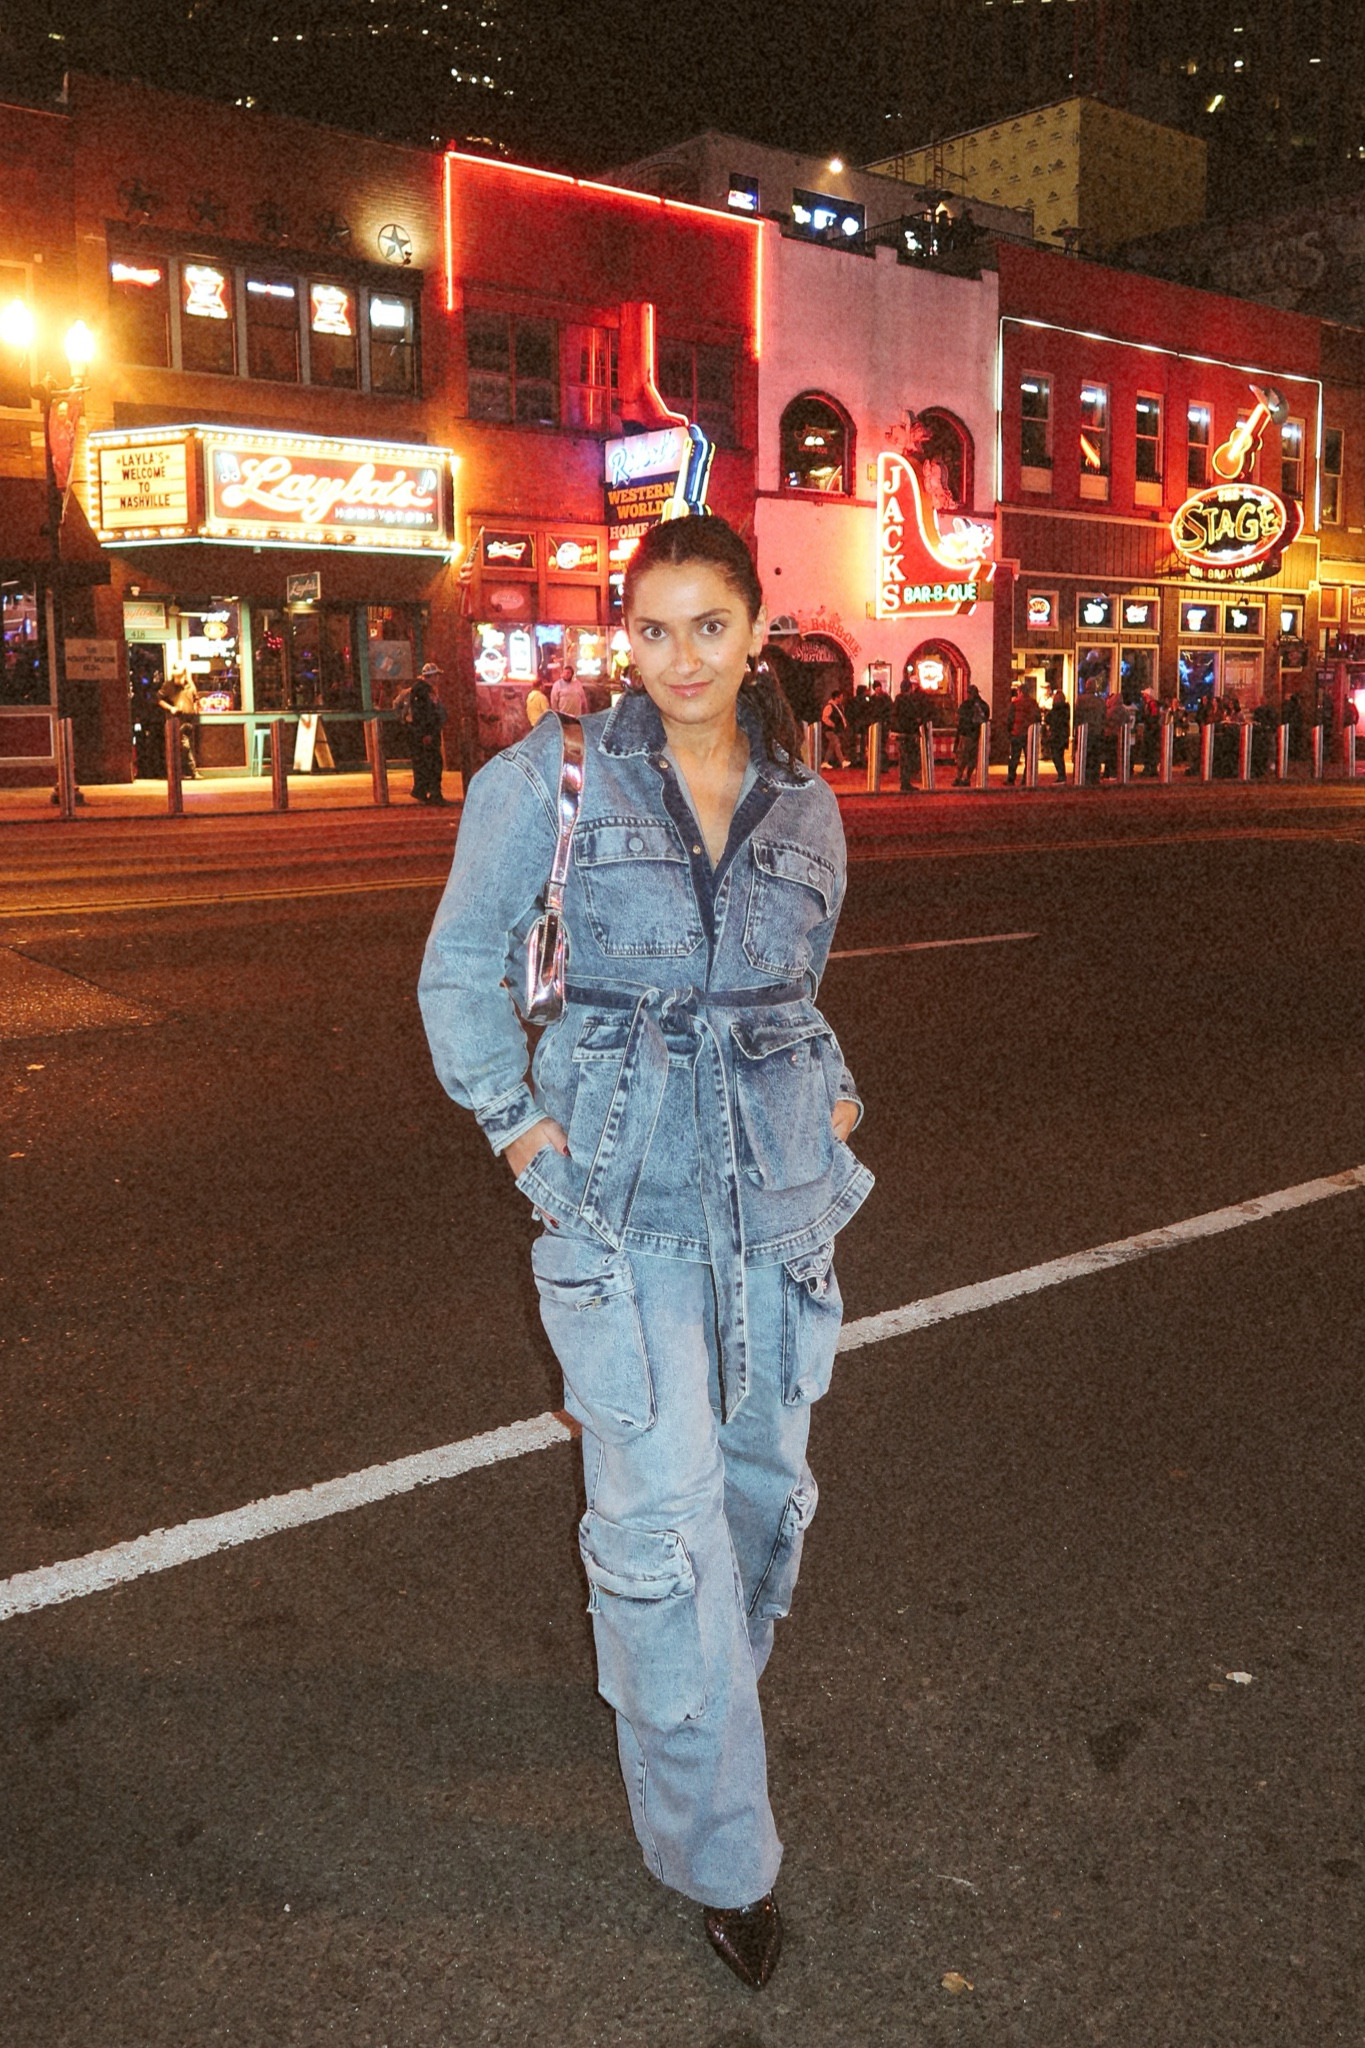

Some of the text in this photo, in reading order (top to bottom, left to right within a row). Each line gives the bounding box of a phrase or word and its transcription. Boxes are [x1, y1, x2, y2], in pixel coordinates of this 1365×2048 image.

[121, 452, 164, 467] LAYLA'S
[122, 466, 166, 481] WELCOME
[138, 481, 151, 493] TO
[221, 456, 434, 523] Layla's
[607, 481, 675, 505] WESTERN
[119, 494, 171, 509] NASHVILLE
[616, 499, 665, 519] WORLD
[1178, 500, 1280, 552] STAGE
[882, 465, 906, 611] JACKS
[1189, 560, 1265, 579] ON BROADWAY
[903, 582, 977, 605] BAR-B-QUE
[199, 697, 230, 708] OPEN
